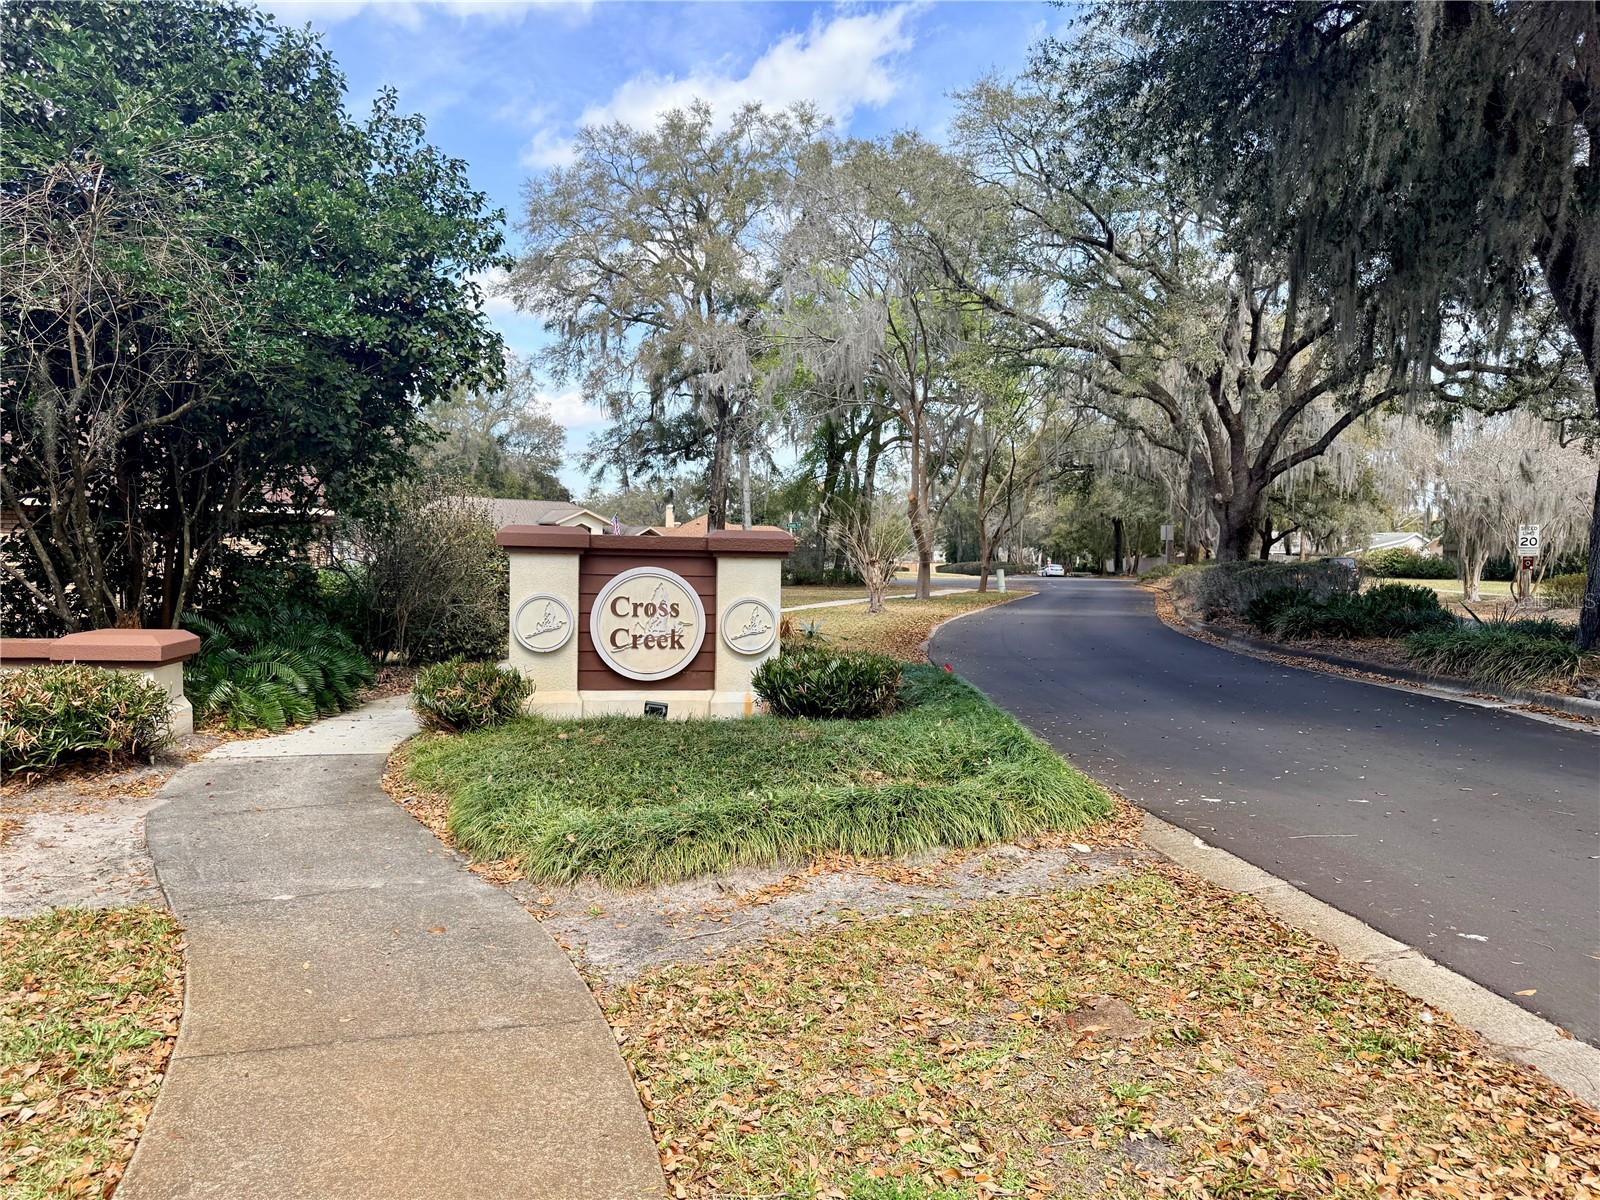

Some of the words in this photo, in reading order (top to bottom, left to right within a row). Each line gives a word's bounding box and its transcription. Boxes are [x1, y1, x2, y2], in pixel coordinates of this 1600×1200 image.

[1520, 537, 1538, 546] 20
[610, 596, 680, 618] Cross
[609, 628, 685, 650] Creek
